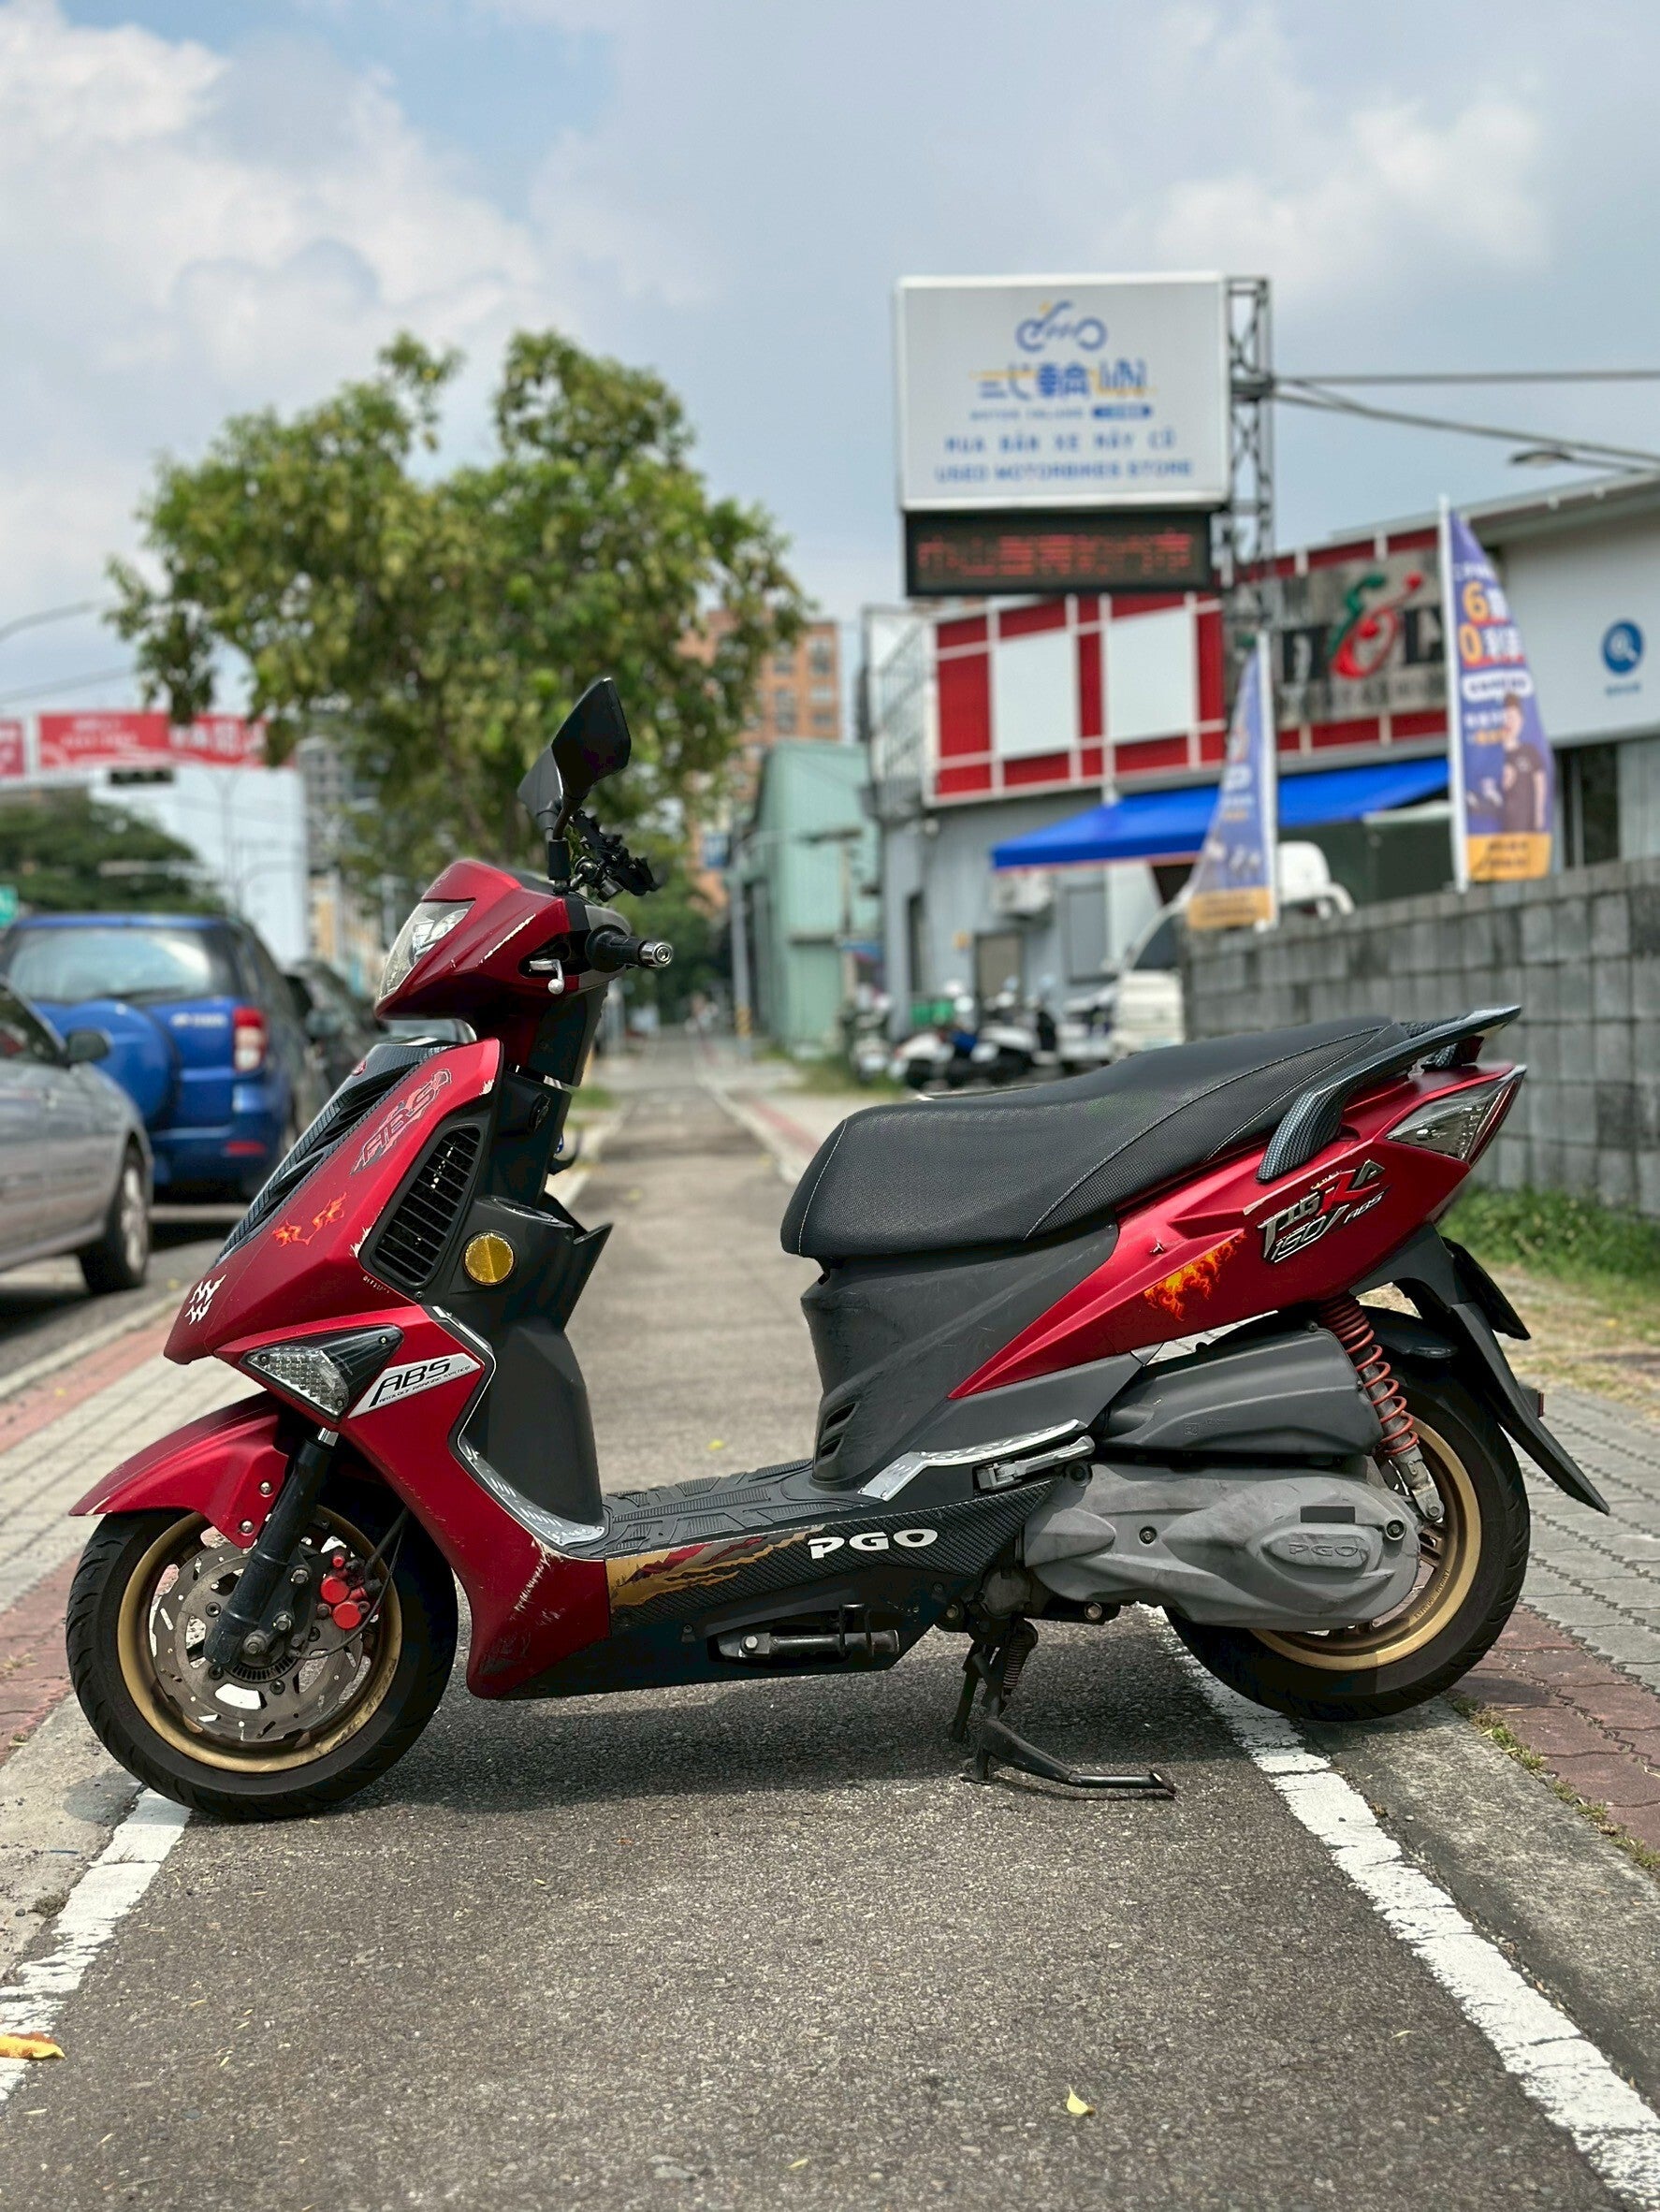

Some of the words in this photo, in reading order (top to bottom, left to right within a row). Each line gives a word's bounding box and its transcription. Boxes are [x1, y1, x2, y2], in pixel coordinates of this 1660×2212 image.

[936, 465, 987, 483] USED
[994, 461, 1122, 481] MOTORBIKES
[1126, 458, 1192, 478] STORE
[1344, 1191, 1385, 1224] ABS
[368, 1358, 451, 1408] ABS
[808, 1529, 939, 1560] PGO
[1288, 1543, 1359, 1557] PGO
